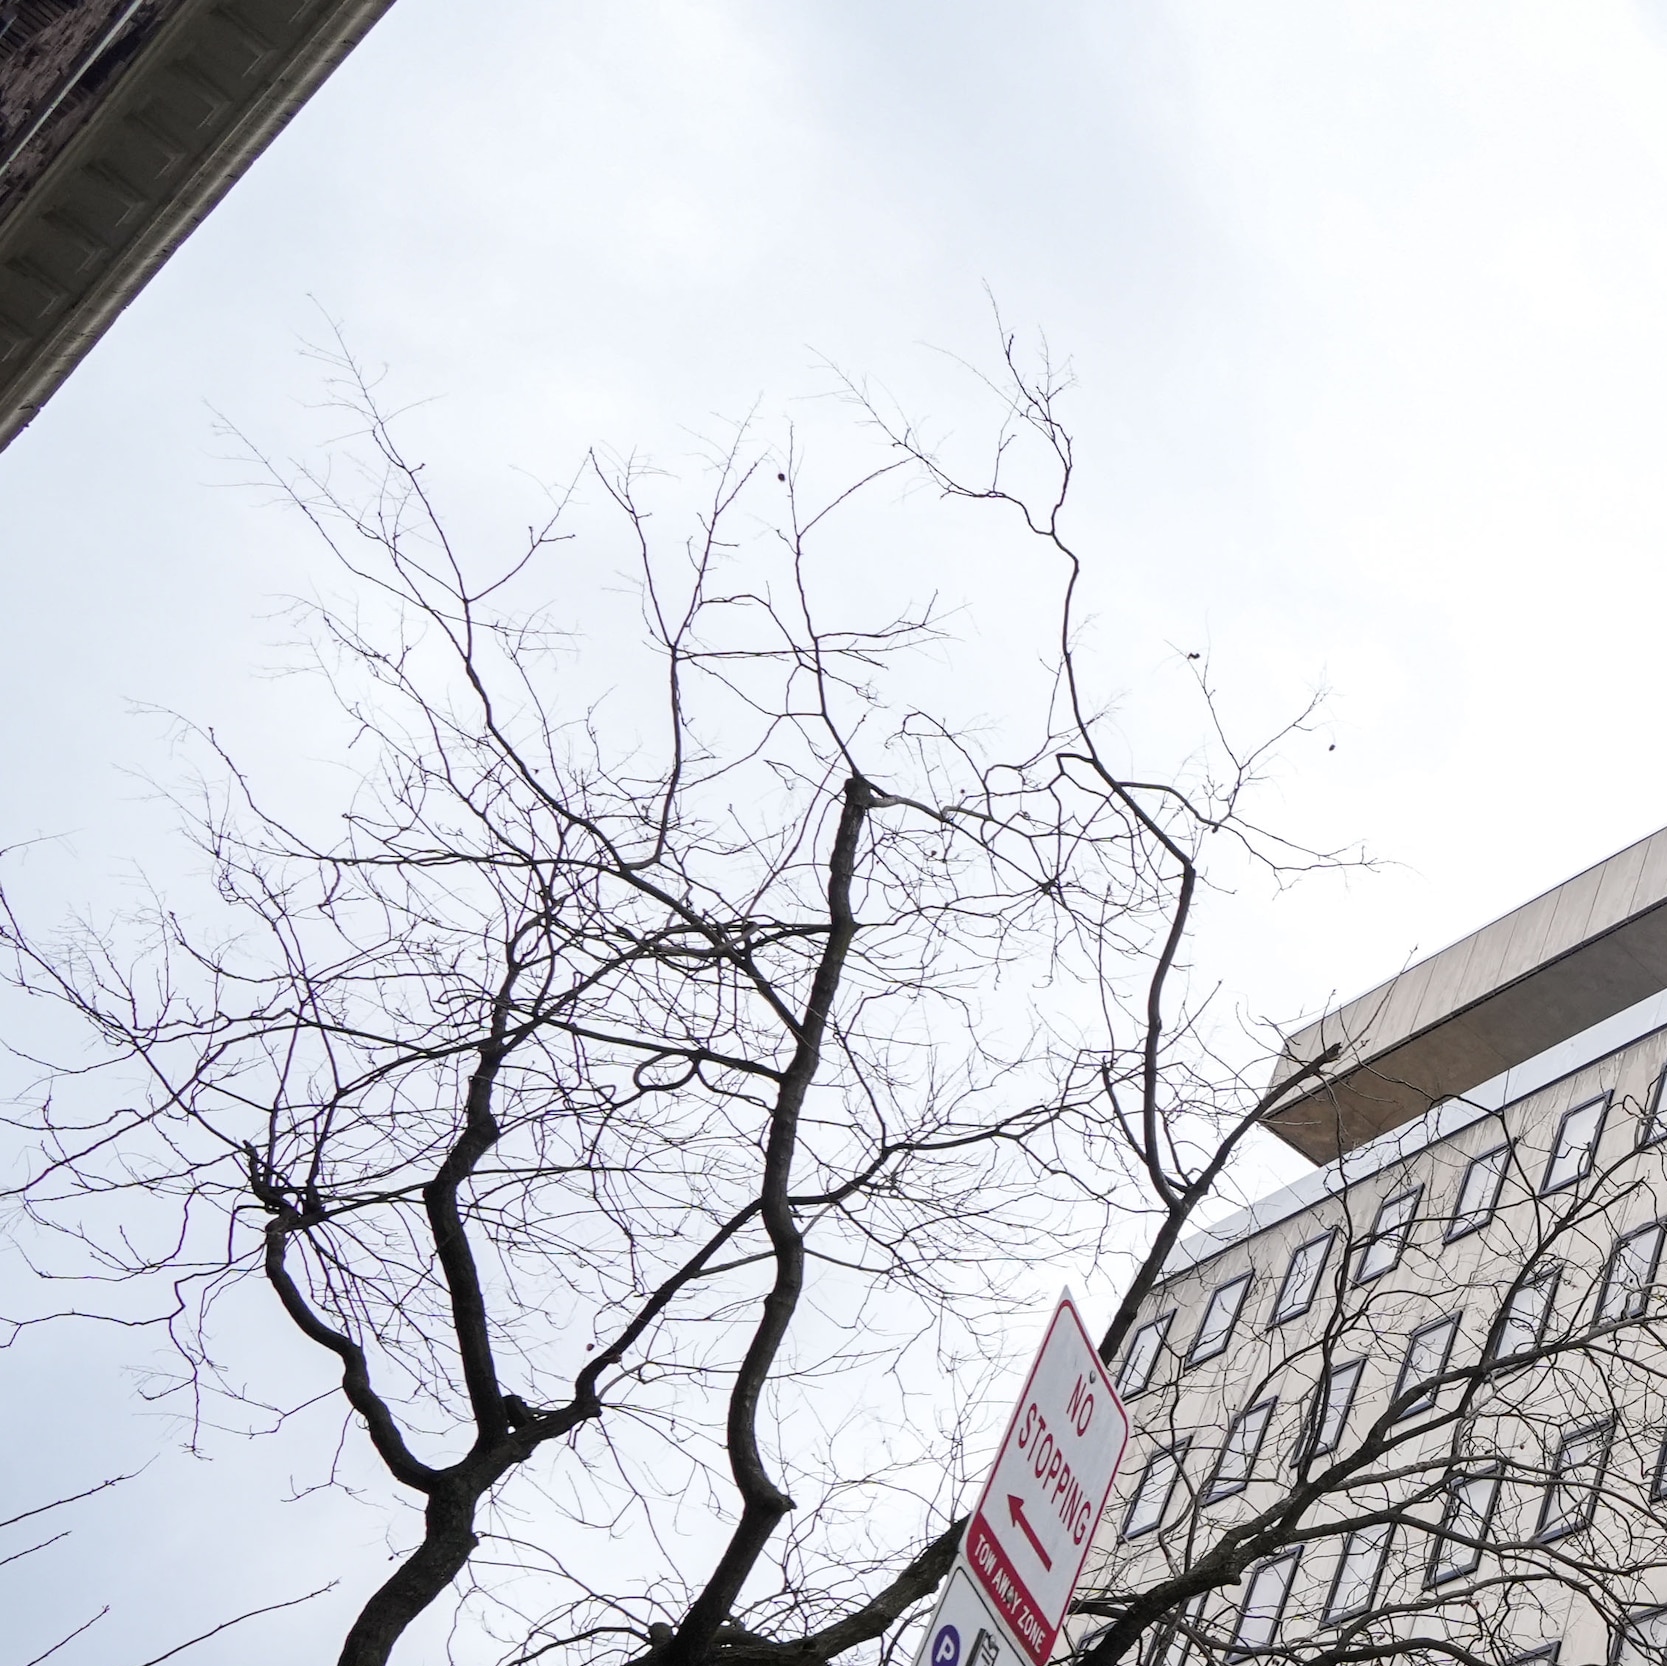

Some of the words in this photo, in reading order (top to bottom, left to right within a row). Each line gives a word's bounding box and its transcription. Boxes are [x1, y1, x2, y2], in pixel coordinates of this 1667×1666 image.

[1066, 1374, 1094, 1437] NO
[1019, 1403, 1091, 1545] STOPPING
[975, 1533, 997, 1576] TOW
[991, 1567, 1022, 1615] AWAY
[1017, 1605, 1046, 1654] ZONE
[935, 1634, 955, 1663] P
